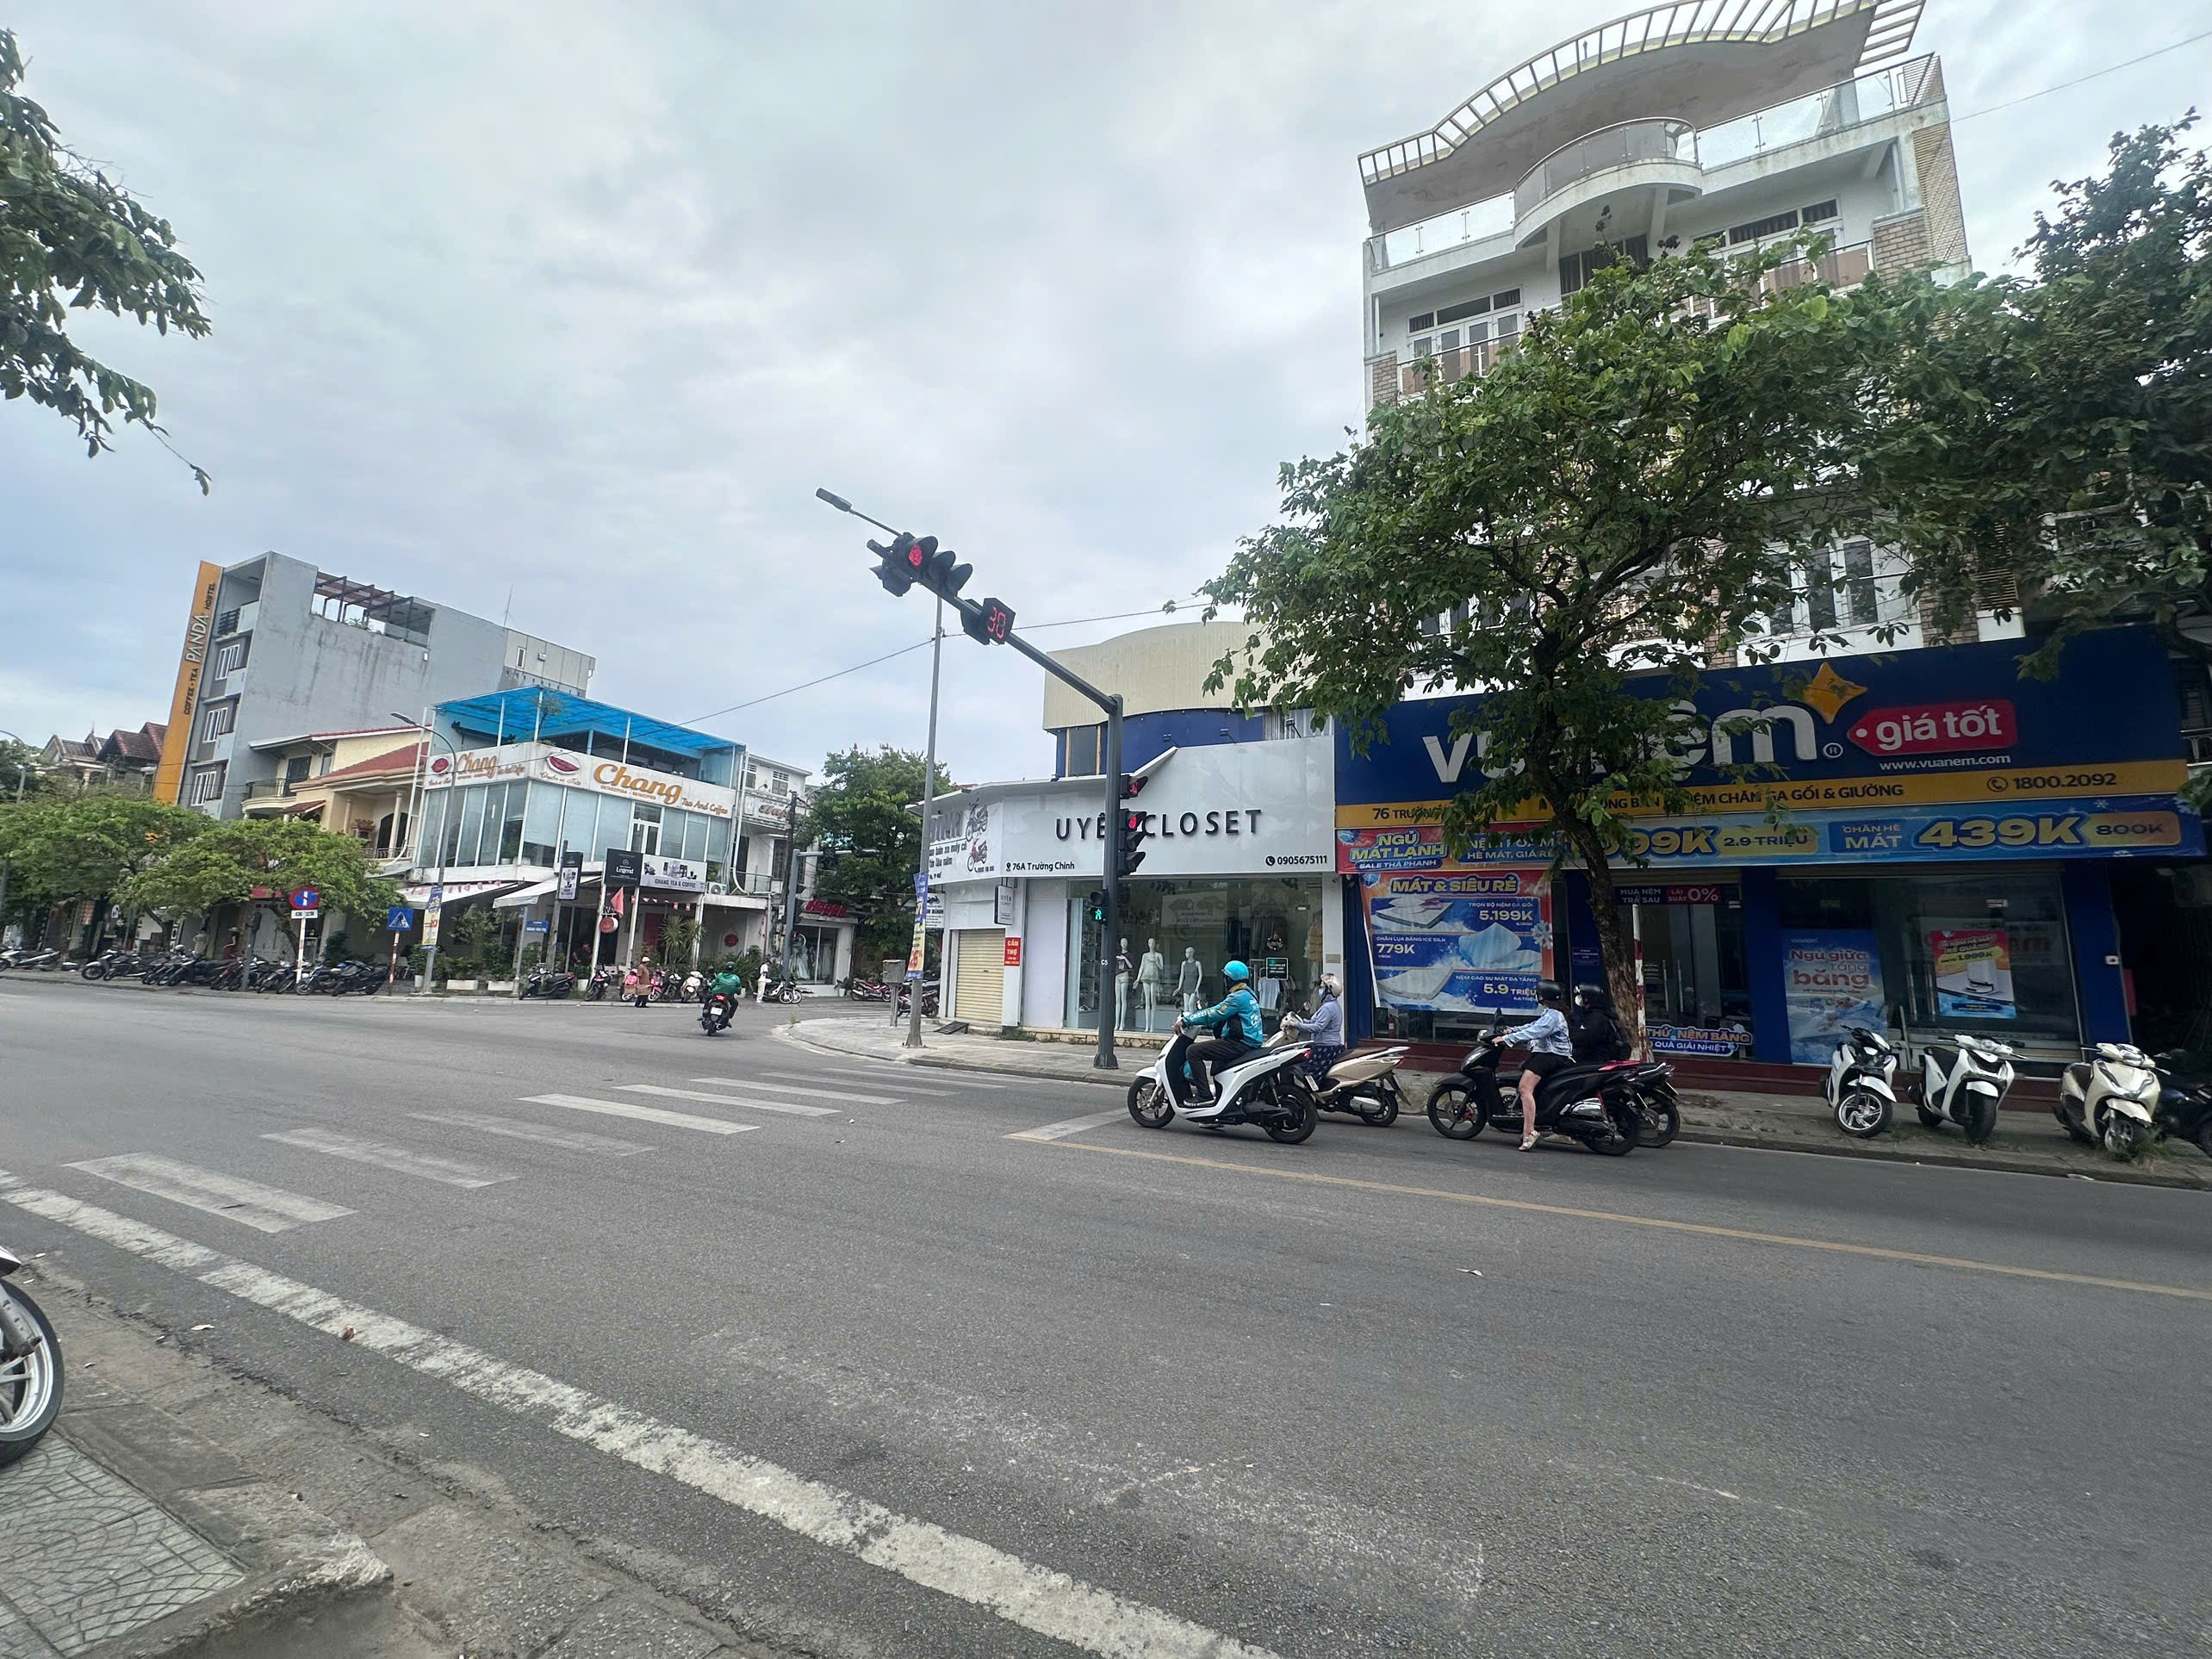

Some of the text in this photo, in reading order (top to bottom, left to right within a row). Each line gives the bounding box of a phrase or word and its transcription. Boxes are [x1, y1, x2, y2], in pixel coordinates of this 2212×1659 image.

[183, 582, 215, 715] COFFEE TEA PANDA HOSTEL
[1876, 705, 2003, 751] giá tốt
[1879, 755, 2011, 770] www.vuanem.com
[593, 763, 683, 805] Chang
[2014, 774, 2116, 790] 1800.2092
[1791, 785, 1819, 800] GỐI
[1824, 787, 1836, 799] &
[1838, 783, 1904, 798] GIƯỜNG
[681, 798, 729, 816] Tea And Coffee
[1372, 808, 1389, 820] 76
[1055, 809, 1262, 840] UYÊ CLOSET
[1842, 823, 1901, 834] CHĂN HÈ
[2095, 823, 2164, 836] 800K
[1378, 830, 1417, 846] NGỦ
[1917, 816, 2082, 848] 439K
[1724, 836, 1750, 847] 2.9
[1845, 833, 1903, 849] MÁT
[1351, 844, 1445, 860] MÁT LẠNH
[1485, 850, 1513, 859] MÁT,
[1516, 849, 1535, 858] GIÁ
[1012, 861, 1075, 872] 76A Trường Chinh
[1277, 854, 1327, 865] 0905675111
[616, 866, 634, 874] Legend
[1392, 875, 1517, 892] MÁT & SIÊU RẺ
[1687, 888, 1719, 902] 0%
[1479, 910, 1533, 921] 5.199K
[1376, 943, 1415, 954] 779K
[1791, 949, 1867, 962] Ngủ giữa
[1793, 968, 1869, 990] băng
[1483, 983, 1537, 997] 5.9 TRIỆU
[1677, 1029, 1708, 1041] NỆM
[1711, 1031, 1750, 1042] BĂNG
[1676, 1041, 1696, 1050] GIẢI
[1697, 1043, 1727, 1053] NHIỆT
